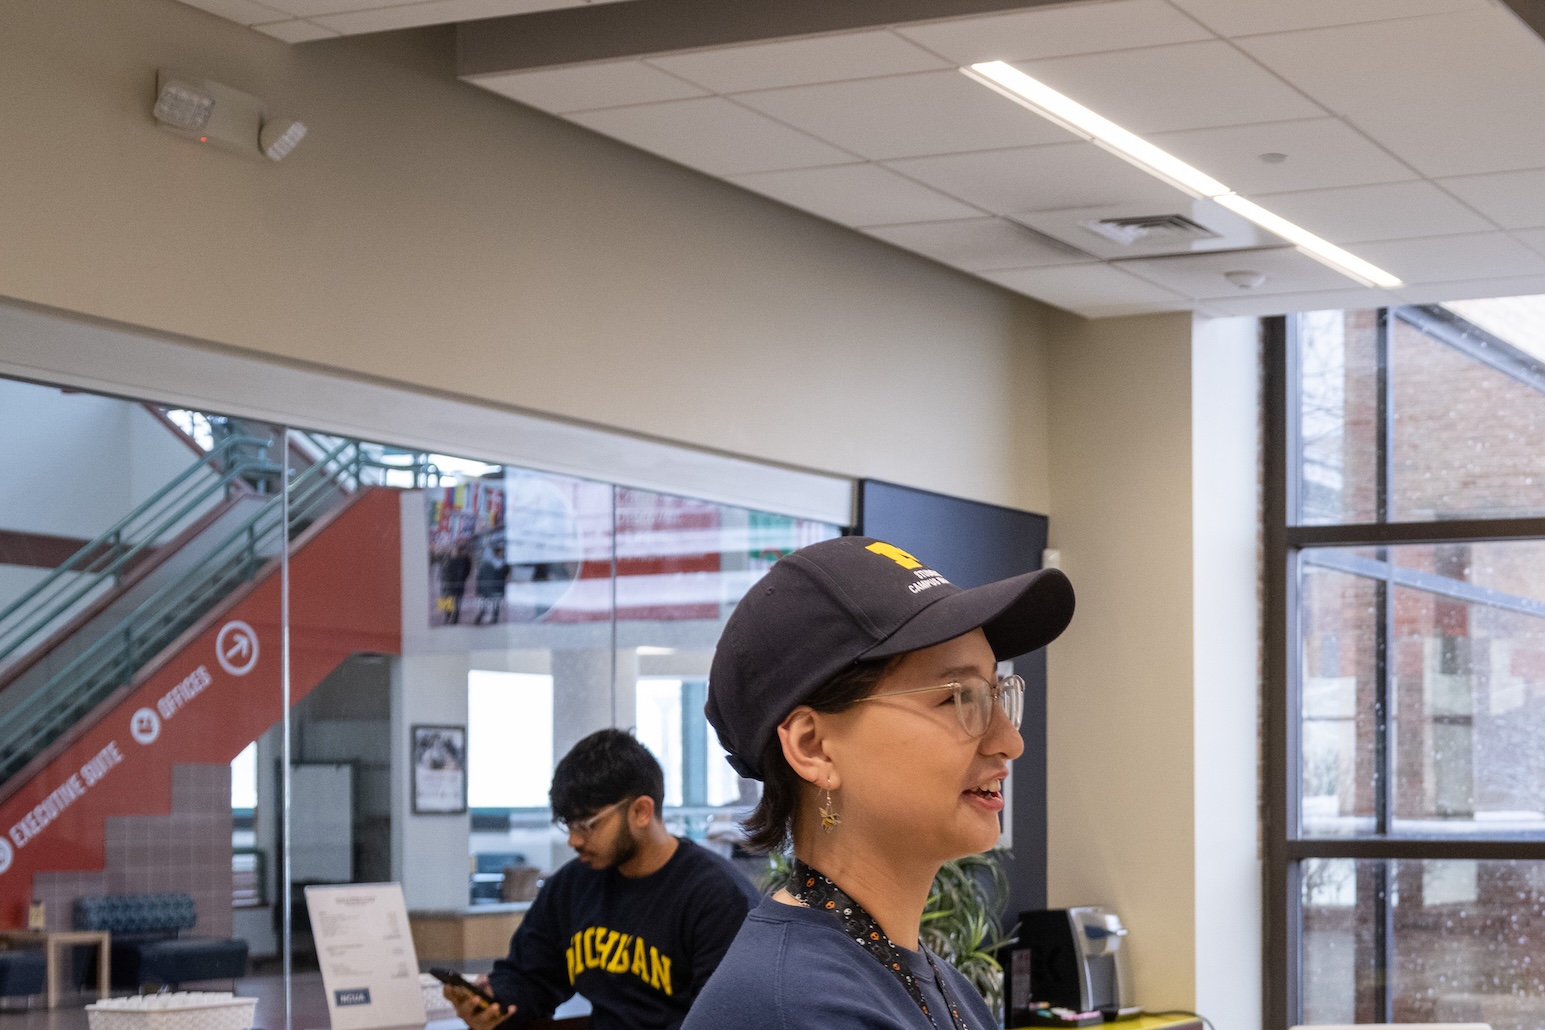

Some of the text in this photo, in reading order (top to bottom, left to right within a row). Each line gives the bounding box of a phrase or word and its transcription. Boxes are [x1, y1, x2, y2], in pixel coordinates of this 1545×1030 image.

[156, 664, 213, 719] OFFICES
[9, 740, 124, 848] EXECUTIVE SUITE
